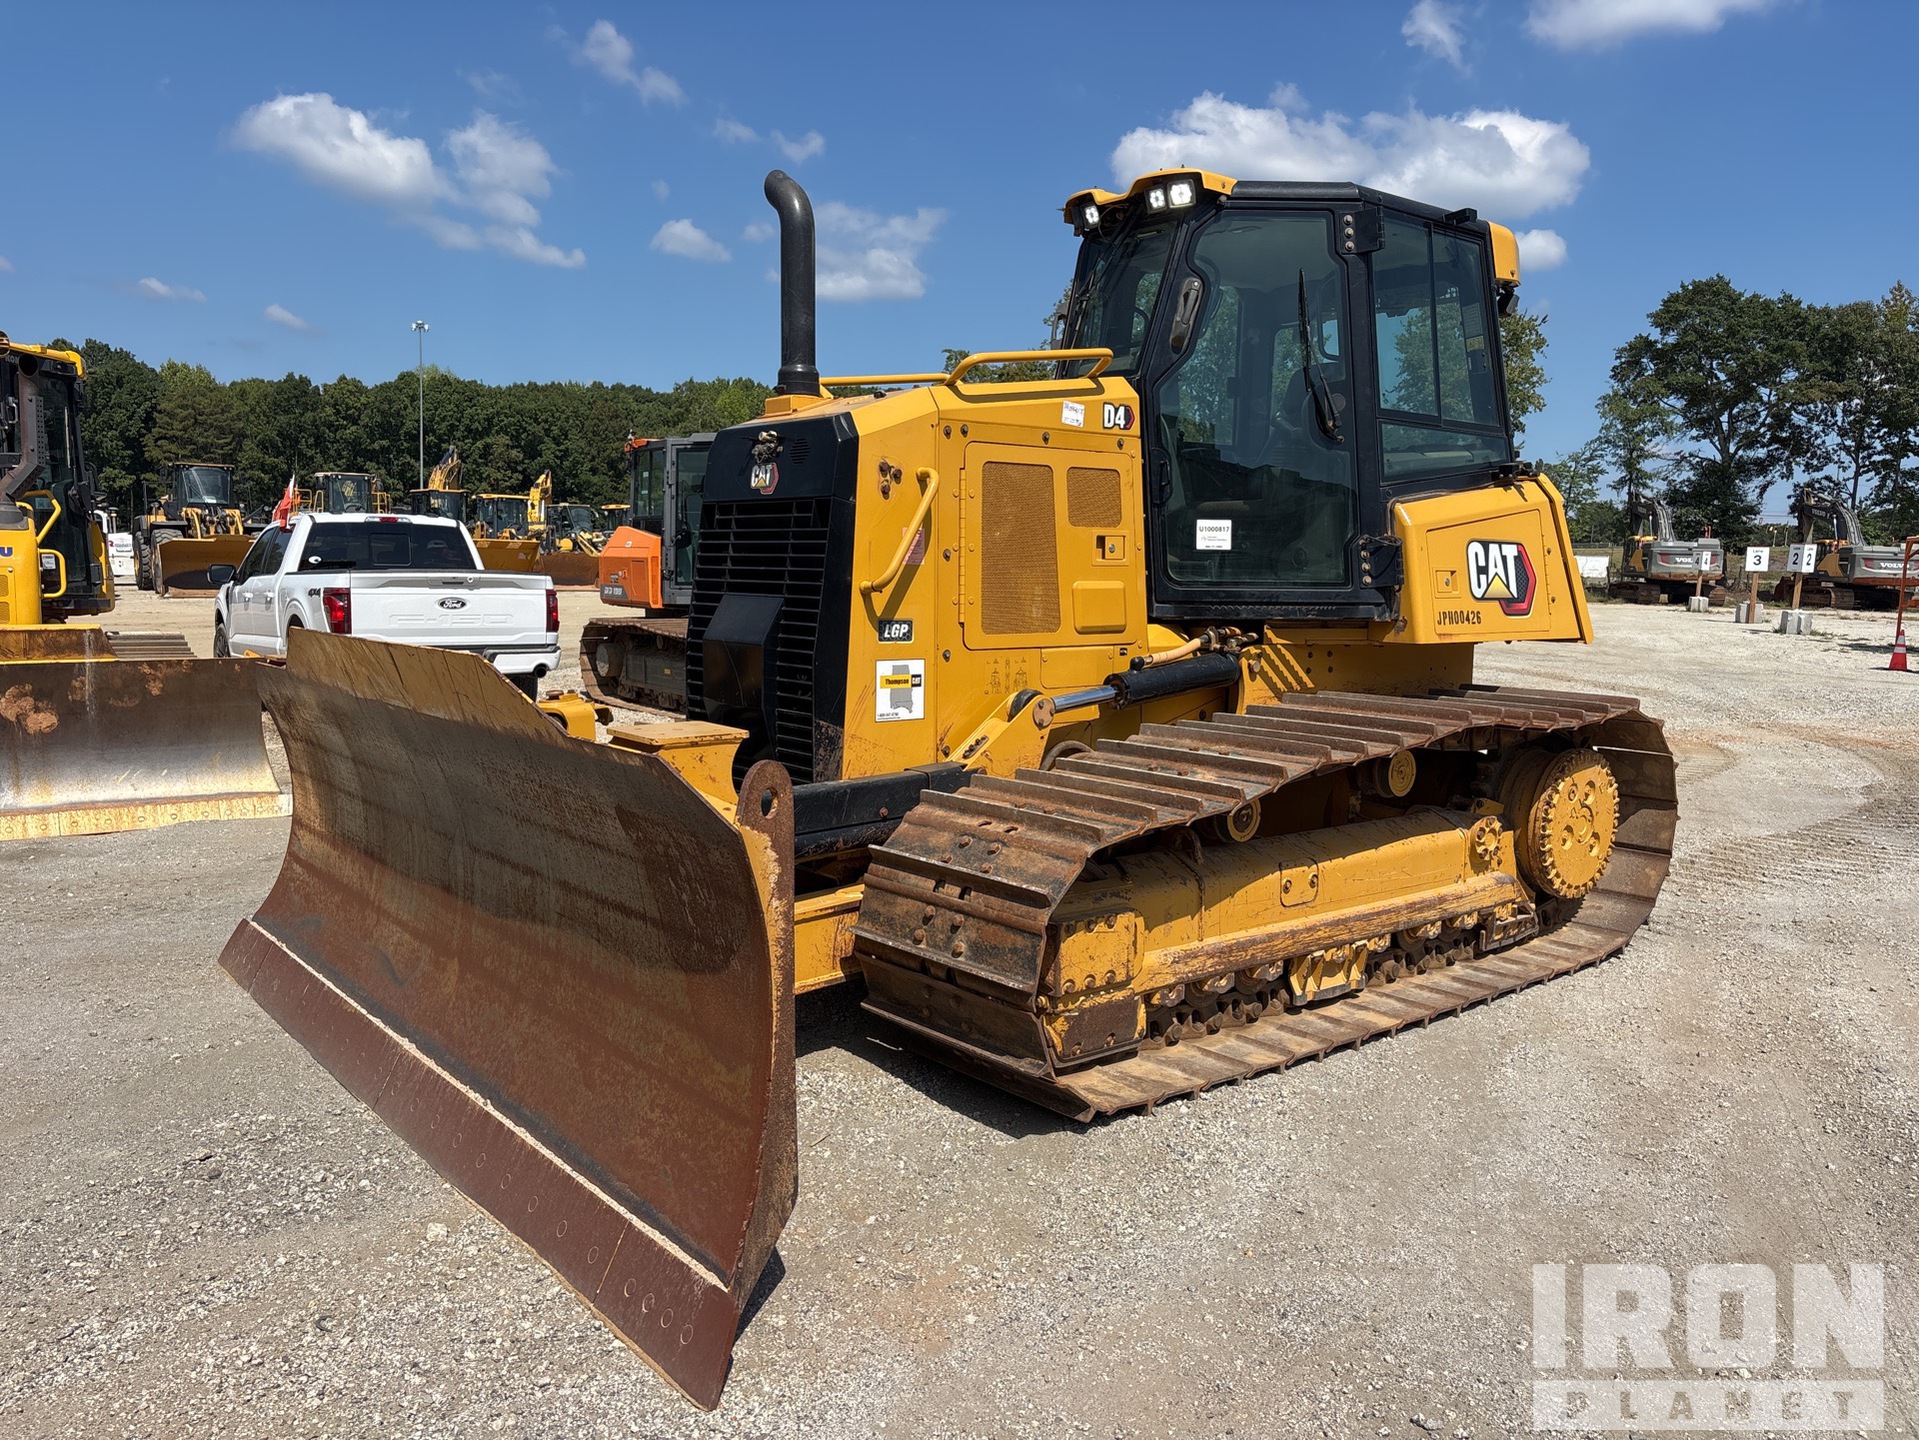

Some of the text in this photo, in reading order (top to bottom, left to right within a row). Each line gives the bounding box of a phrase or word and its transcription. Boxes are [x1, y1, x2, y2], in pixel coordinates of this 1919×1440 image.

[1104, 404, 1126, 429] D4
[751, 464, 773, 488] CAT
[1753, 555, 1762, 566] 3
[1792, 552, 1799, 565] 2
[1806, 553, 1812, 566] 2
[1467, 541, 1518, 599] CAT
[443, 599, 462, 609] Ford
[389, 614, 514, 627] F-150
[884, 624, 909, 638] LGP
